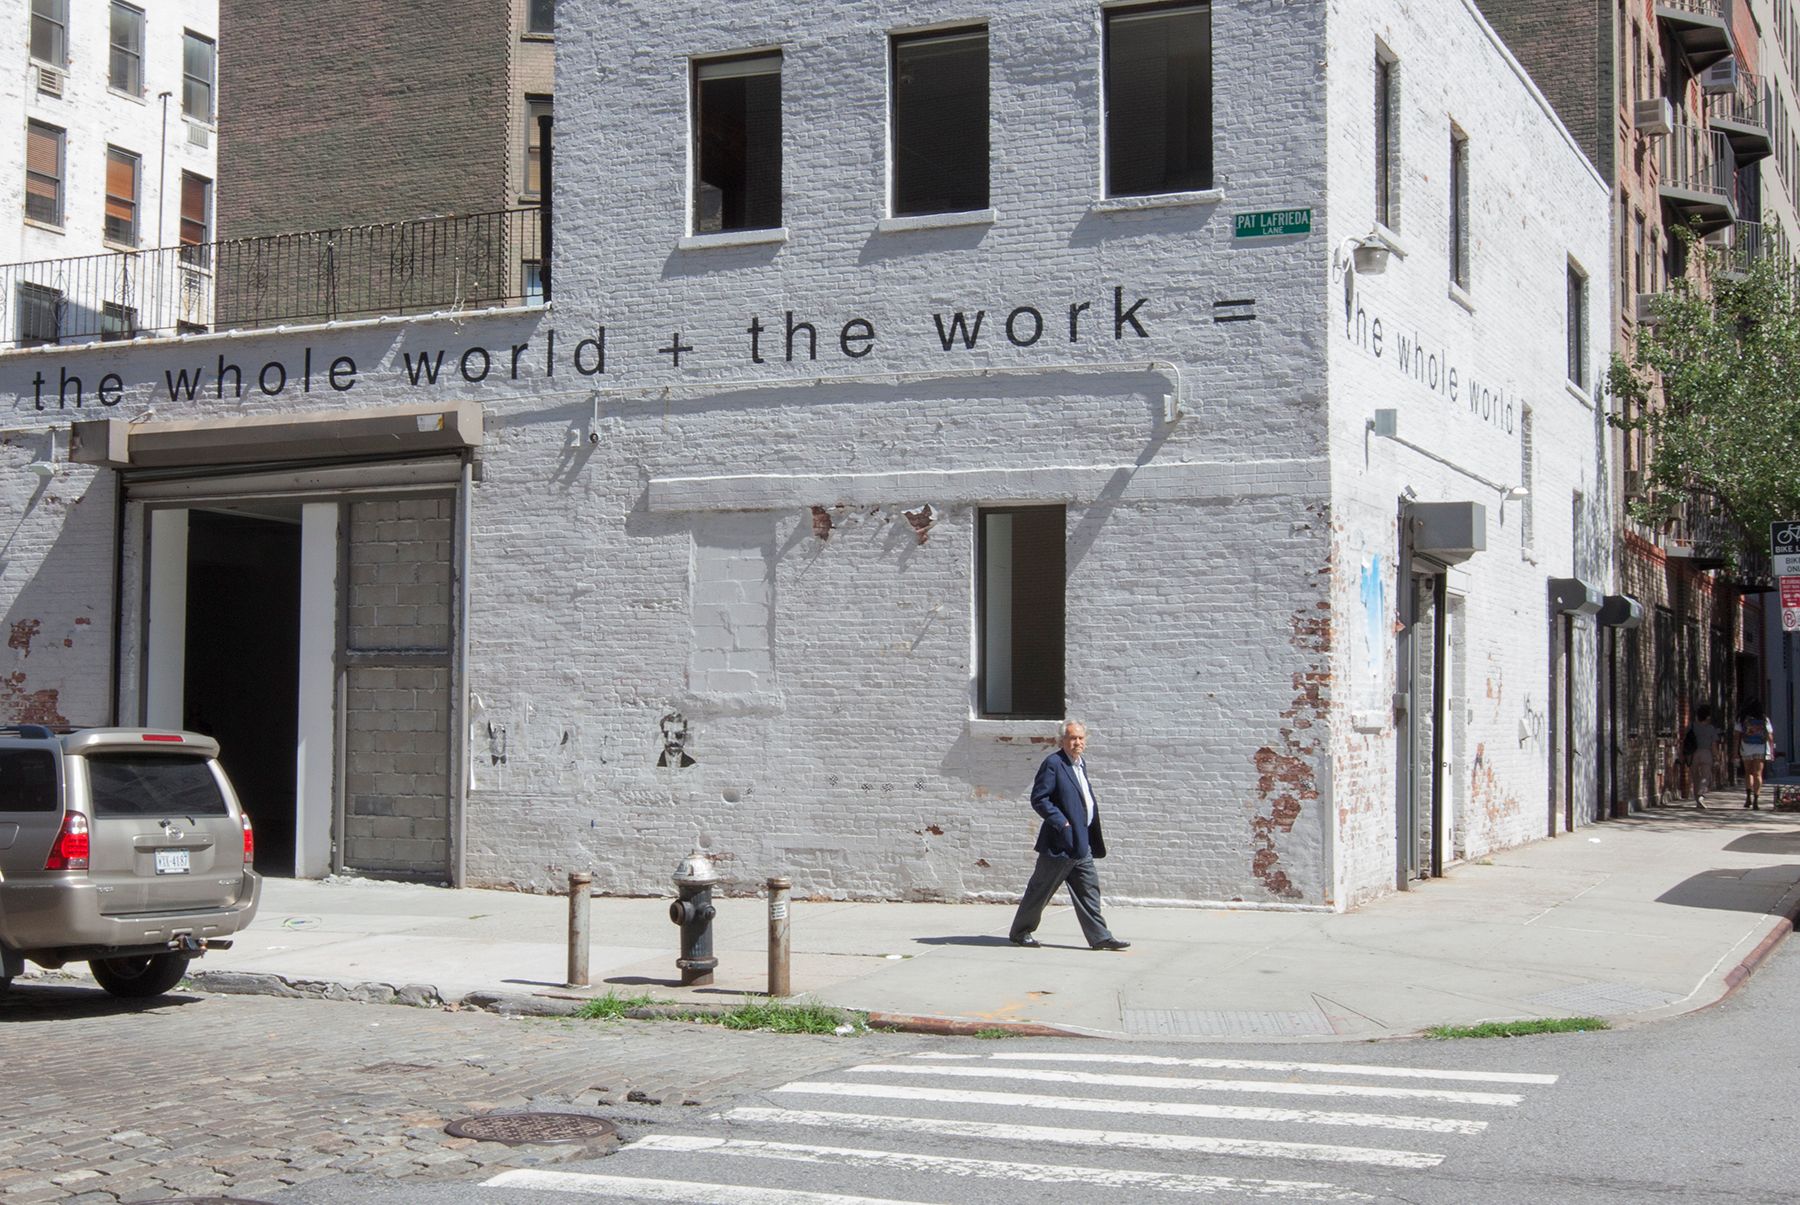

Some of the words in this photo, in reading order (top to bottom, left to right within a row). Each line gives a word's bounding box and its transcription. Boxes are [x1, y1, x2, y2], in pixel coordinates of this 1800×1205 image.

[1238, 214, 1256, 229] PAT
[1262, 226, 1284, 235] LANE
[31, 365, 123, 411] the
[164, 346, 358, 402] whole
[403, 326, 606, 386] world
[658, 332, 692, 367] +
[747, 311, 875, 364] the
[933, 286, 1150, 352] work
[1345, 287, 1384, 358] the
[1397, 331, 1459, 402] whole
[1468, 378, 1514, 435] world
[1775, 545, 1793, 553] BIKE
